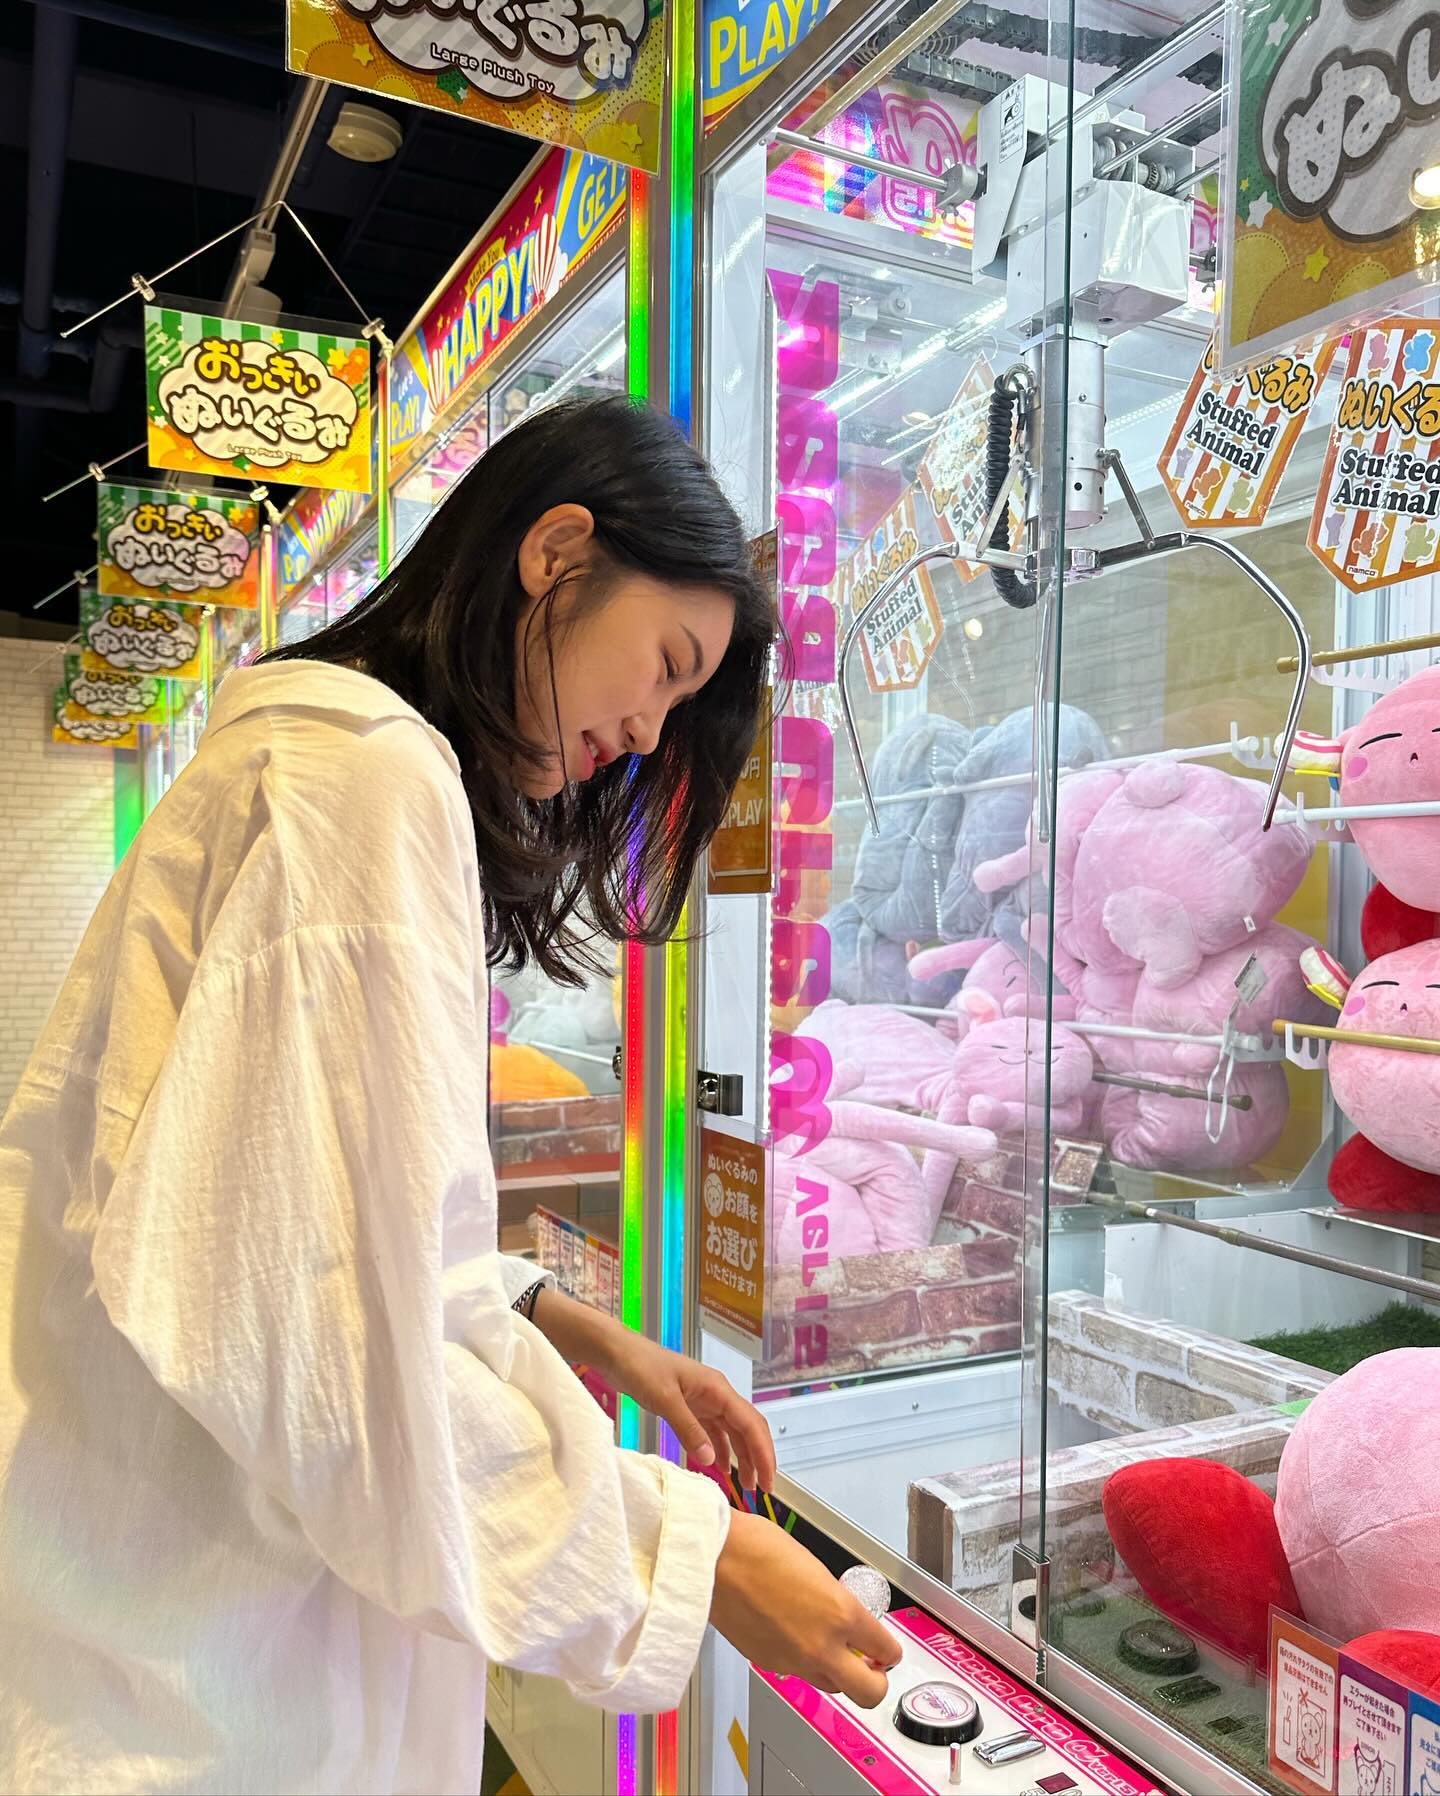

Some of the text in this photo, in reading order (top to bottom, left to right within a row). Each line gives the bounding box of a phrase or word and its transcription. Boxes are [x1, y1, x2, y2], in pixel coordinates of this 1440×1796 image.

[343, 0, 634, 81] ぐるみ
[430, 43, 556, 95] Large Plush Toy
[440, 230, 537, 394] HAPPY!
[197, 338, 319, 396] おっきい
[166, 386, 352, 451] ぬいぐるみ
[1198, 391, 1278, 449] Stuffed
[1186, 418, 1266, 477] Animal
[133, 504, 224, 541] おっきい
[1185, 501, 1206, 517] namco
[1332, 478, 1440, 516] Animal
[113, 536, 248, 578] ぬいぐるみ
[1348, 566, 1377, 577] namco
[865, 577, 917, 637] Stuffed
[872, 596, 923, 656] Animal
[707, 1152, 758, 1186] ぬいぐるみの
[724, 1187, 758, 1225] お顔を
[705, 1220, 758, 1272] お選び
